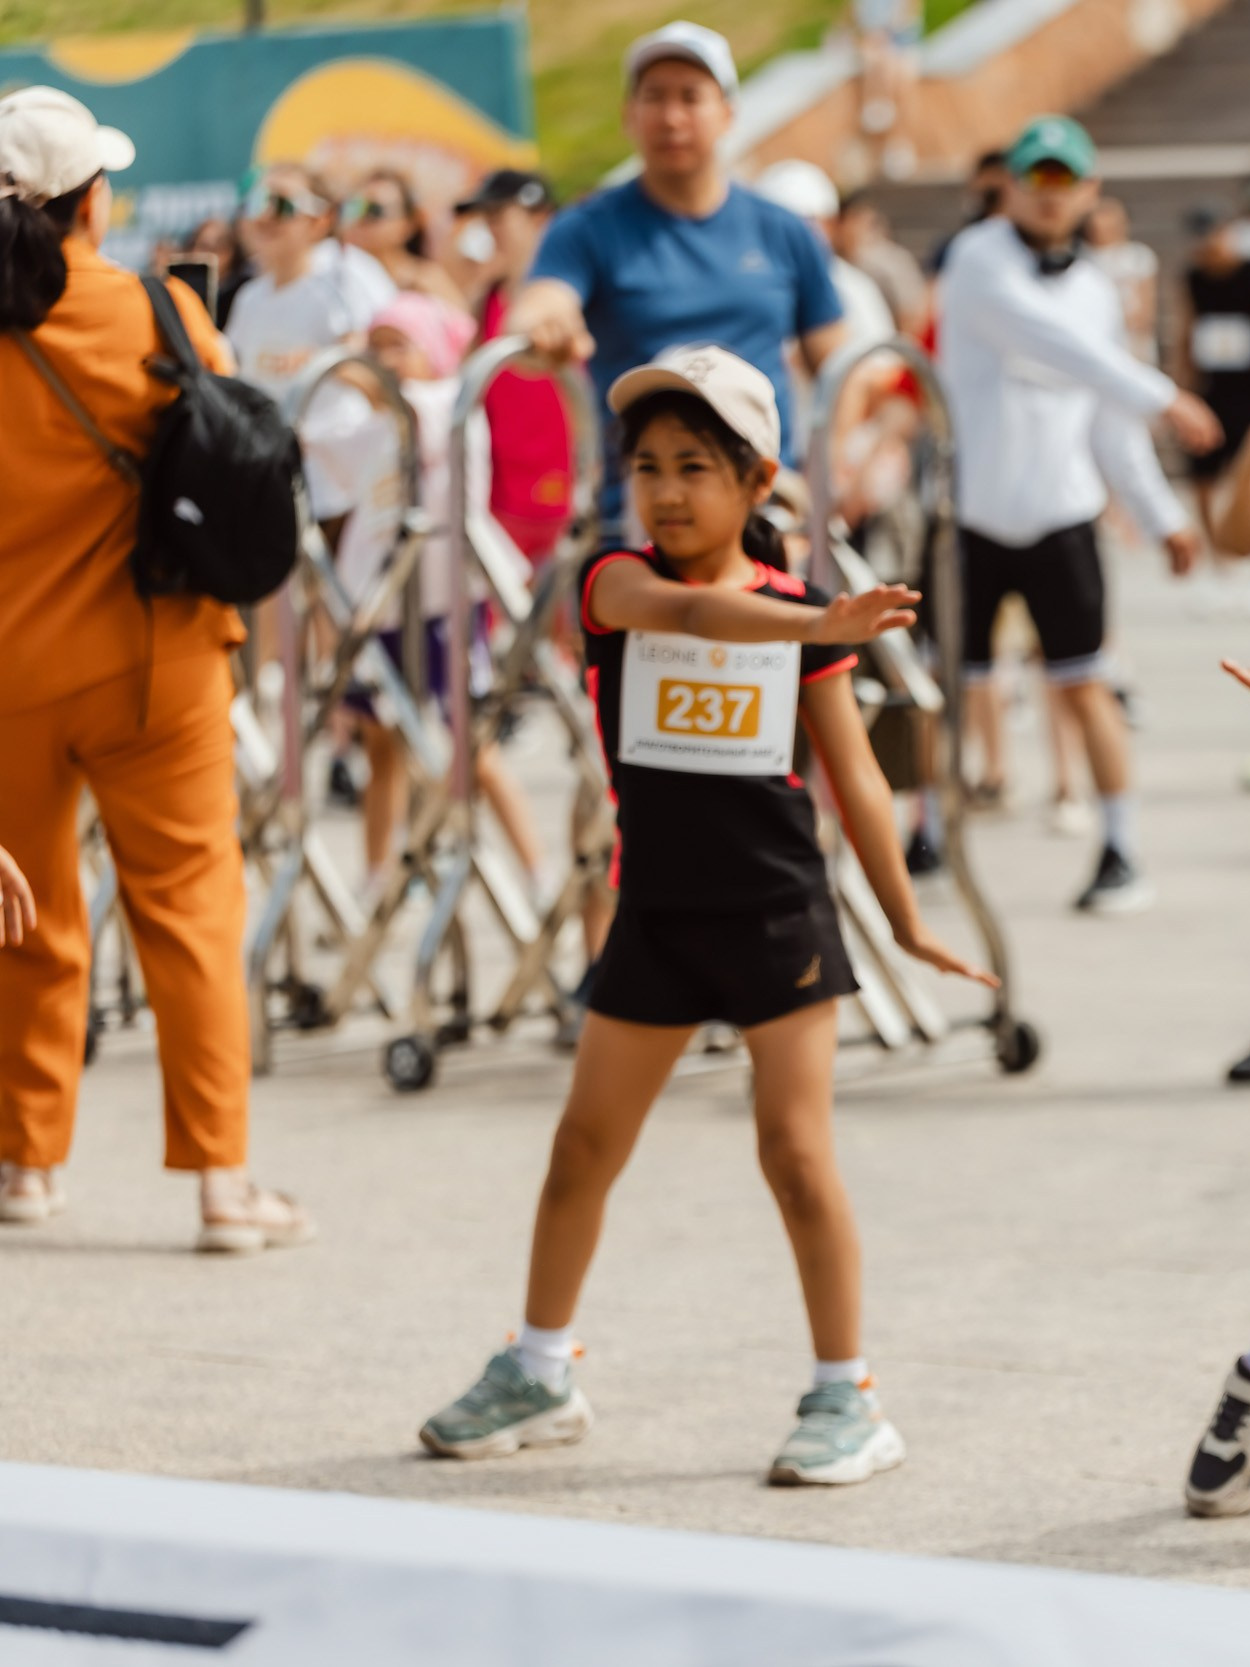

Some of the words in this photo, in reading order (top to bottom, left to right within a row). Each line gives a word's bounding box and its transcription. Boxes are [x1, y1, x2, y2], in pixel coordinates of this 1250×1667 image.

[640, 645, 697, 667] LEONE
[735, 652, 786, 671] DORO
[665, 685, 754, 733] 237
